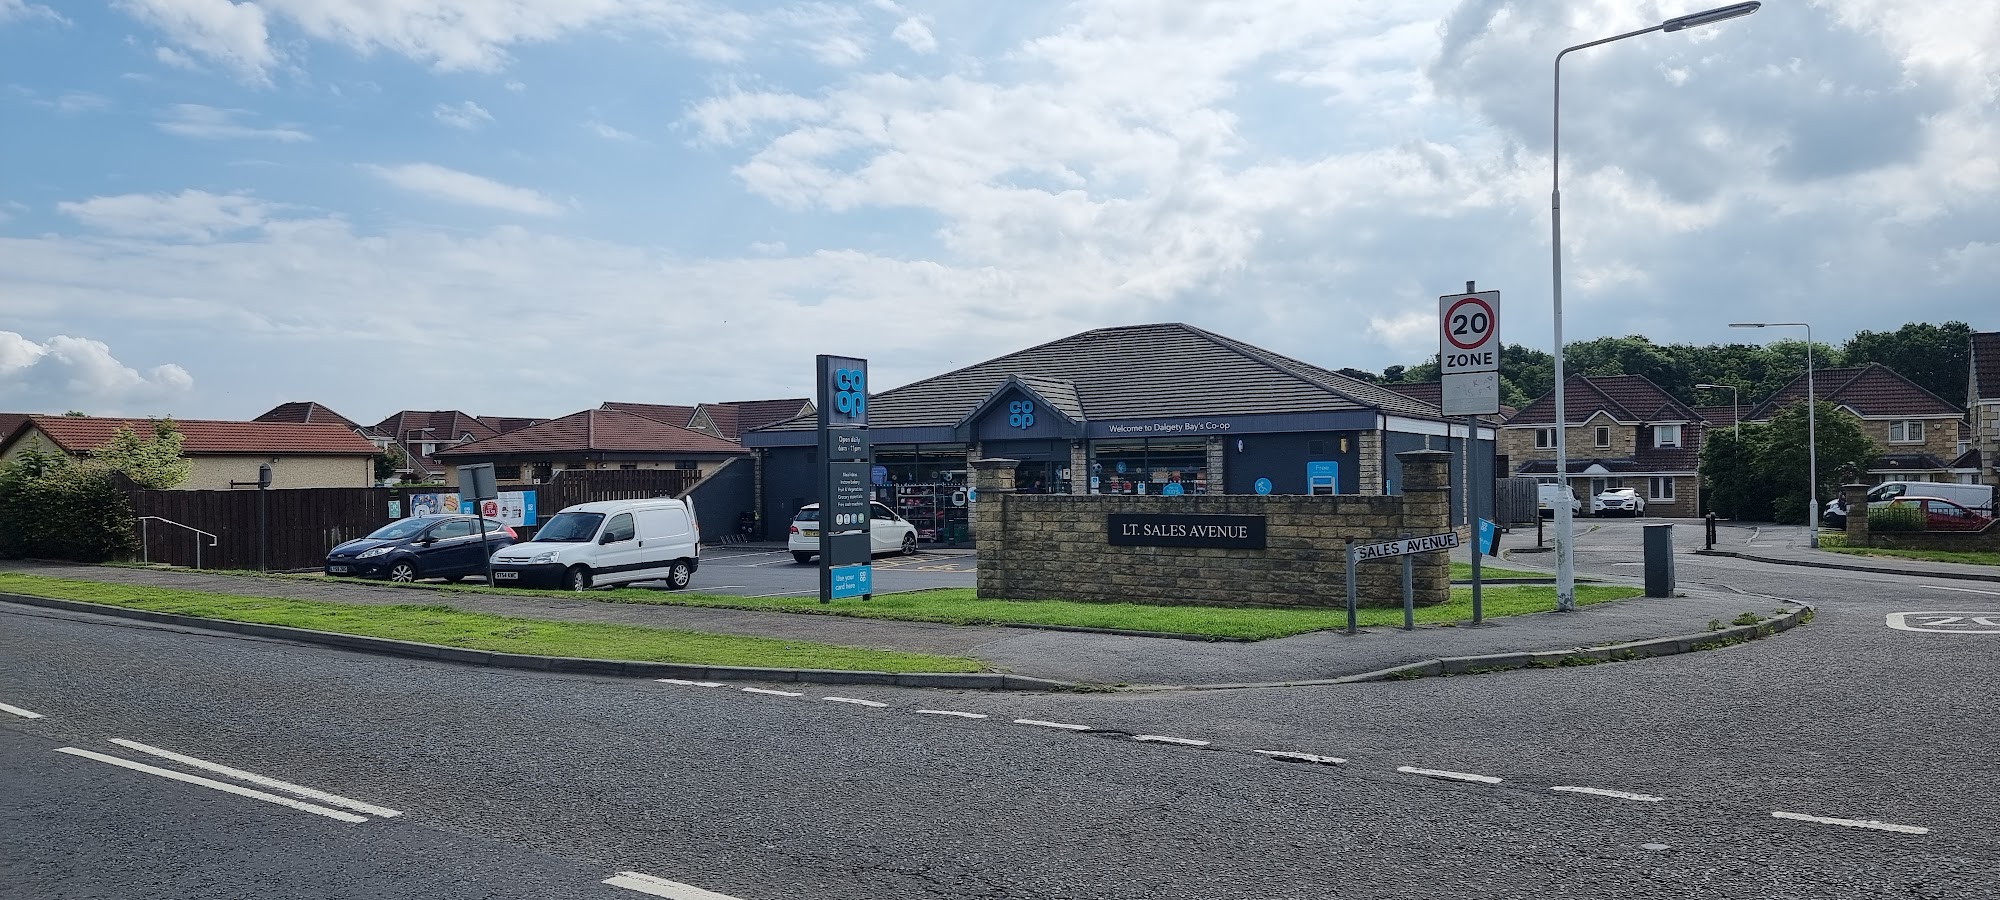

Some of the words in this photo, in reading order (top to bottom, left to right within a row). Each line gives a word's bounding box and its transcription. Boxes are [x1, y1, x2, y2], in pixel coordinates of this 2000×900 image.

[1452, 312, 1488, 335] 20
[1447, 352, 1493, 367] ZONE
[1154, 423, 1183, 433] Dalgety
[1184, 422, 1204, 431] Bay's
[1206, 422, 1230, 430] Co-op
[839, 436, 850, 444] Open
[851, 436, 860, 444] daily
[850, 445, 861, 453] 11pm
[1122, 523, 1140, 536] LT.
[1143, 523, 1187, 537] SALES
[1189, 525, 1248, 539] AVENUE
[1359, 542, 1400, 559] SALES
[1406, 534, 1456, 553] AVENUE
